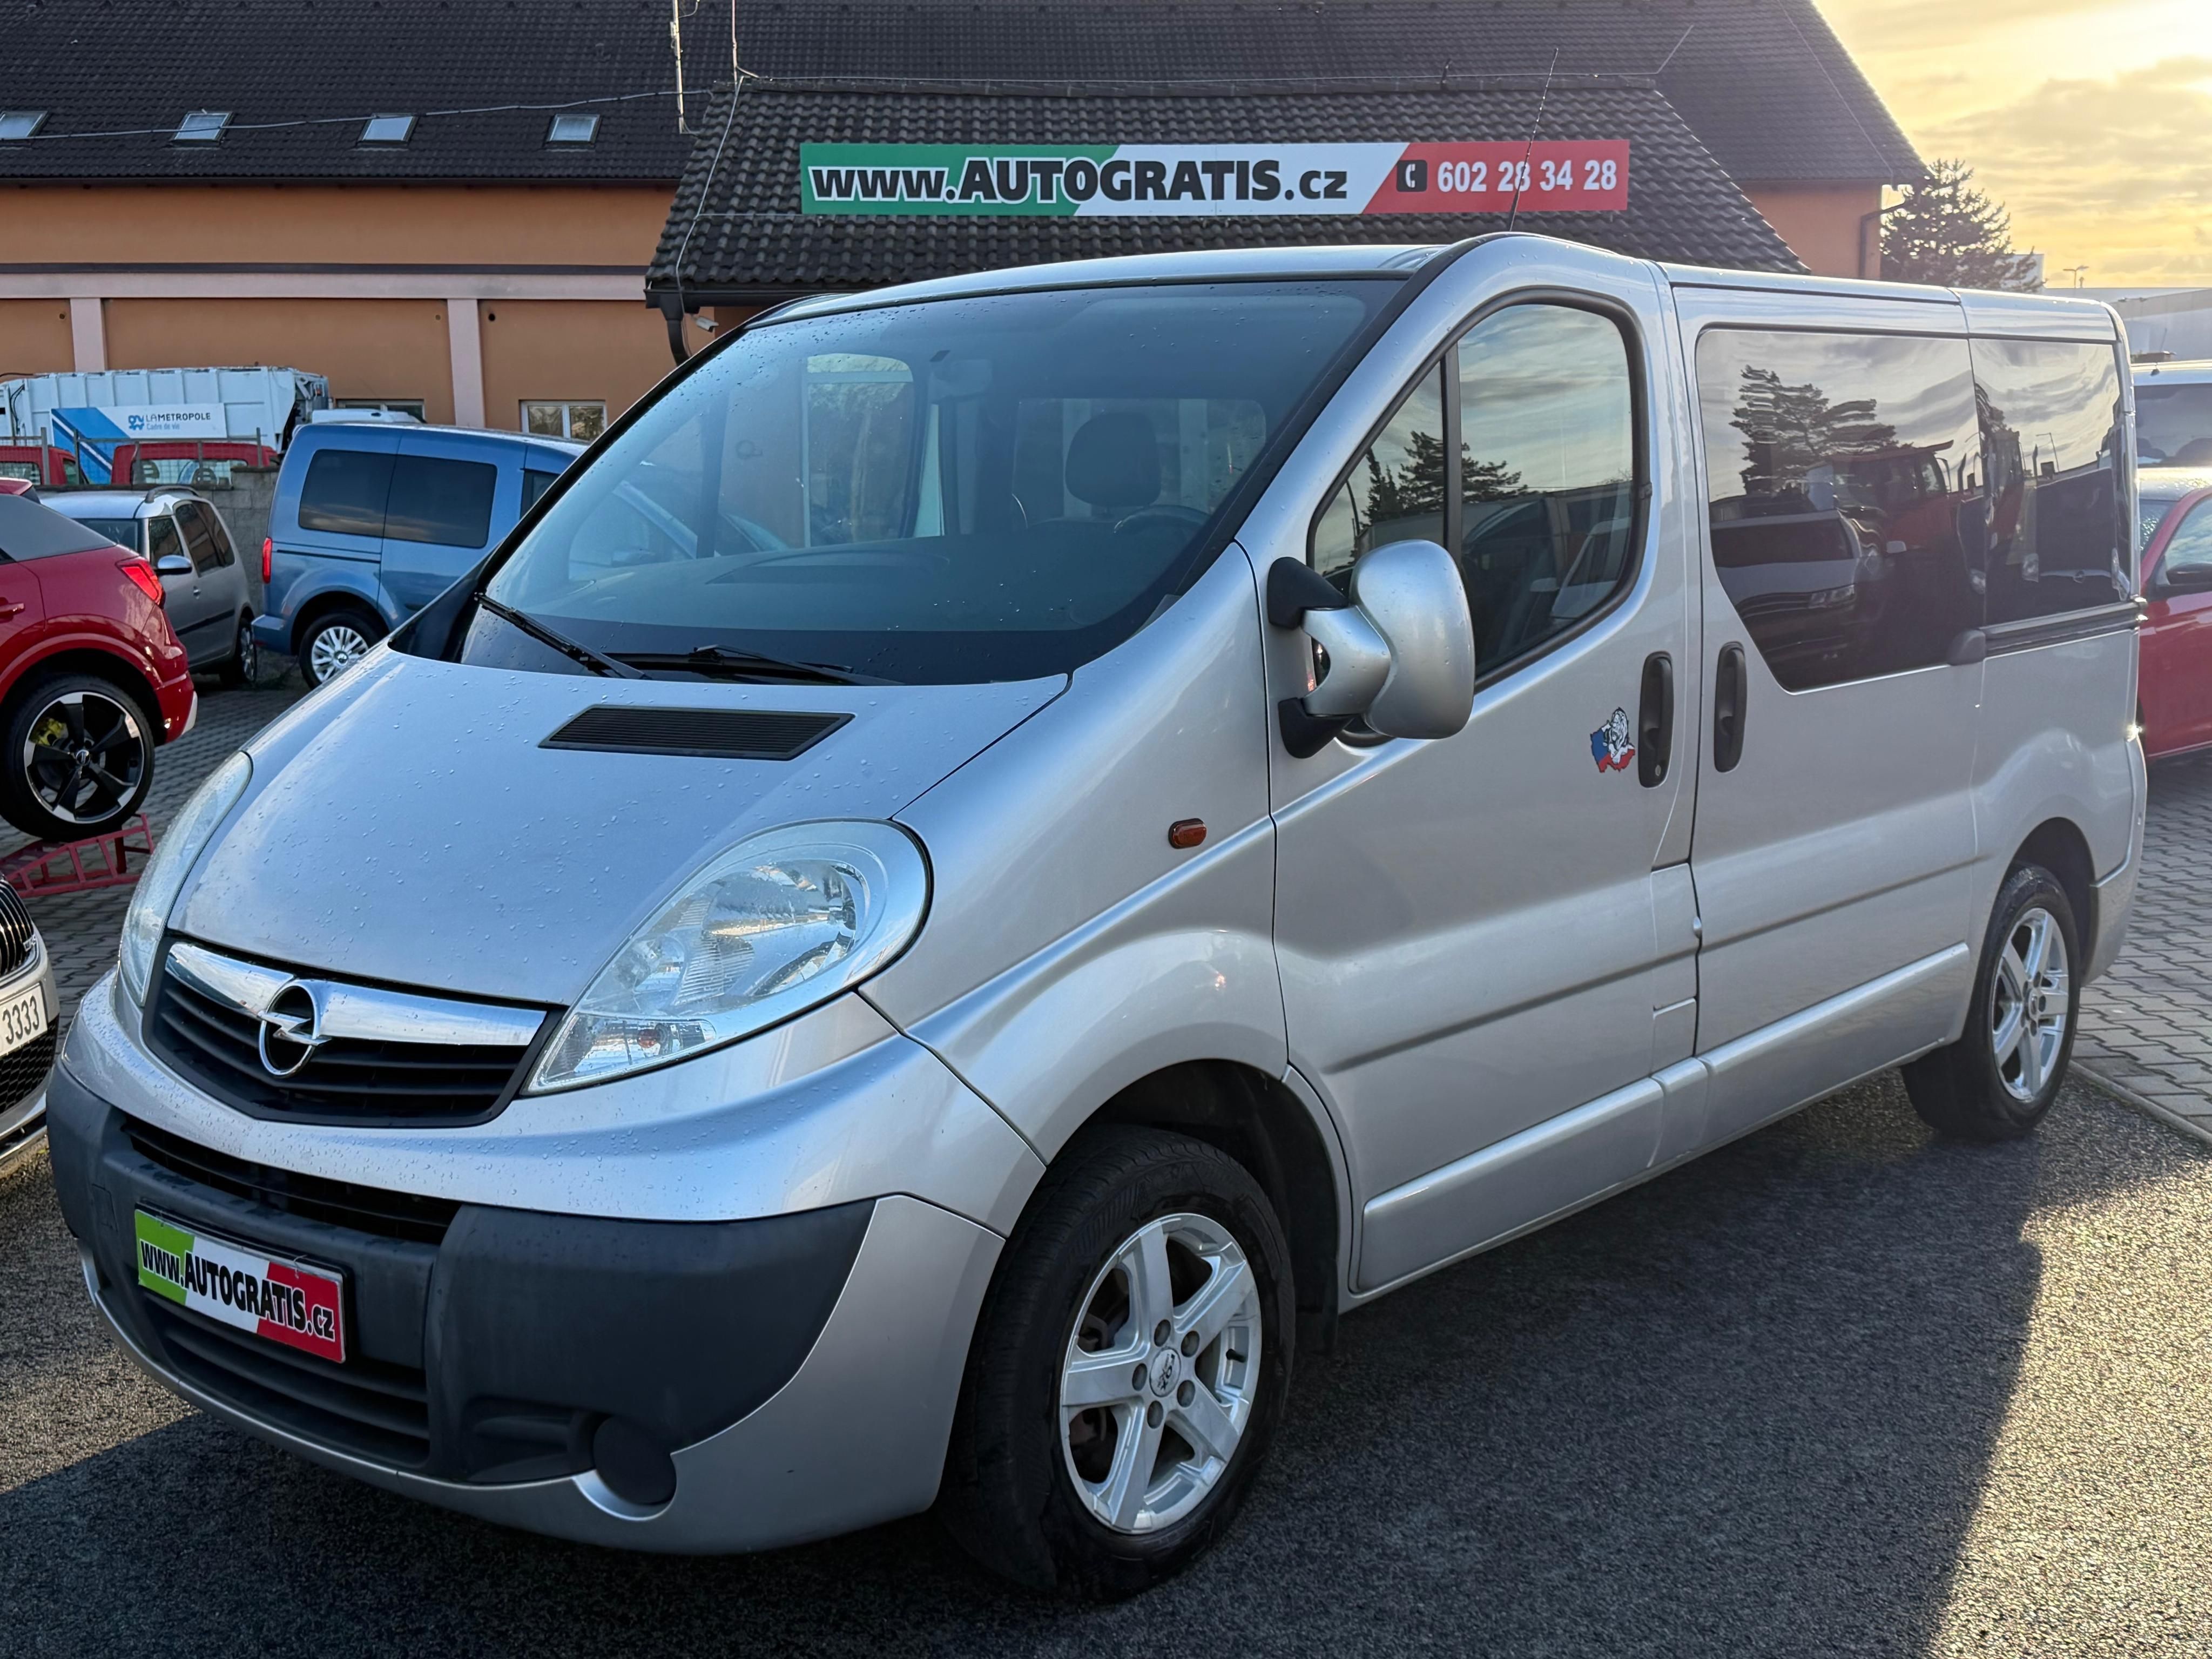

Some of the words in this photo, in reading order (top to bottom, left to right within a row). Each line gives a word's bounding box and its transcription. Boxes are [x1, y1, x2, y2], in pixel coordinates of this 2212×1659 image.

[812, 160, 1347, 201] www.AUTOGRATIS.cz
[1437, 161, 1487, 193] 602
[1498, 160, 1532, 192] 28
[1539, 160, 1574, 191] 34
[1583, 159, 1617, 191] 28
[2, 994, 39, 1045] 3333
[140, 1240, 335, 1340] www.AUTOGRATIS.cz
